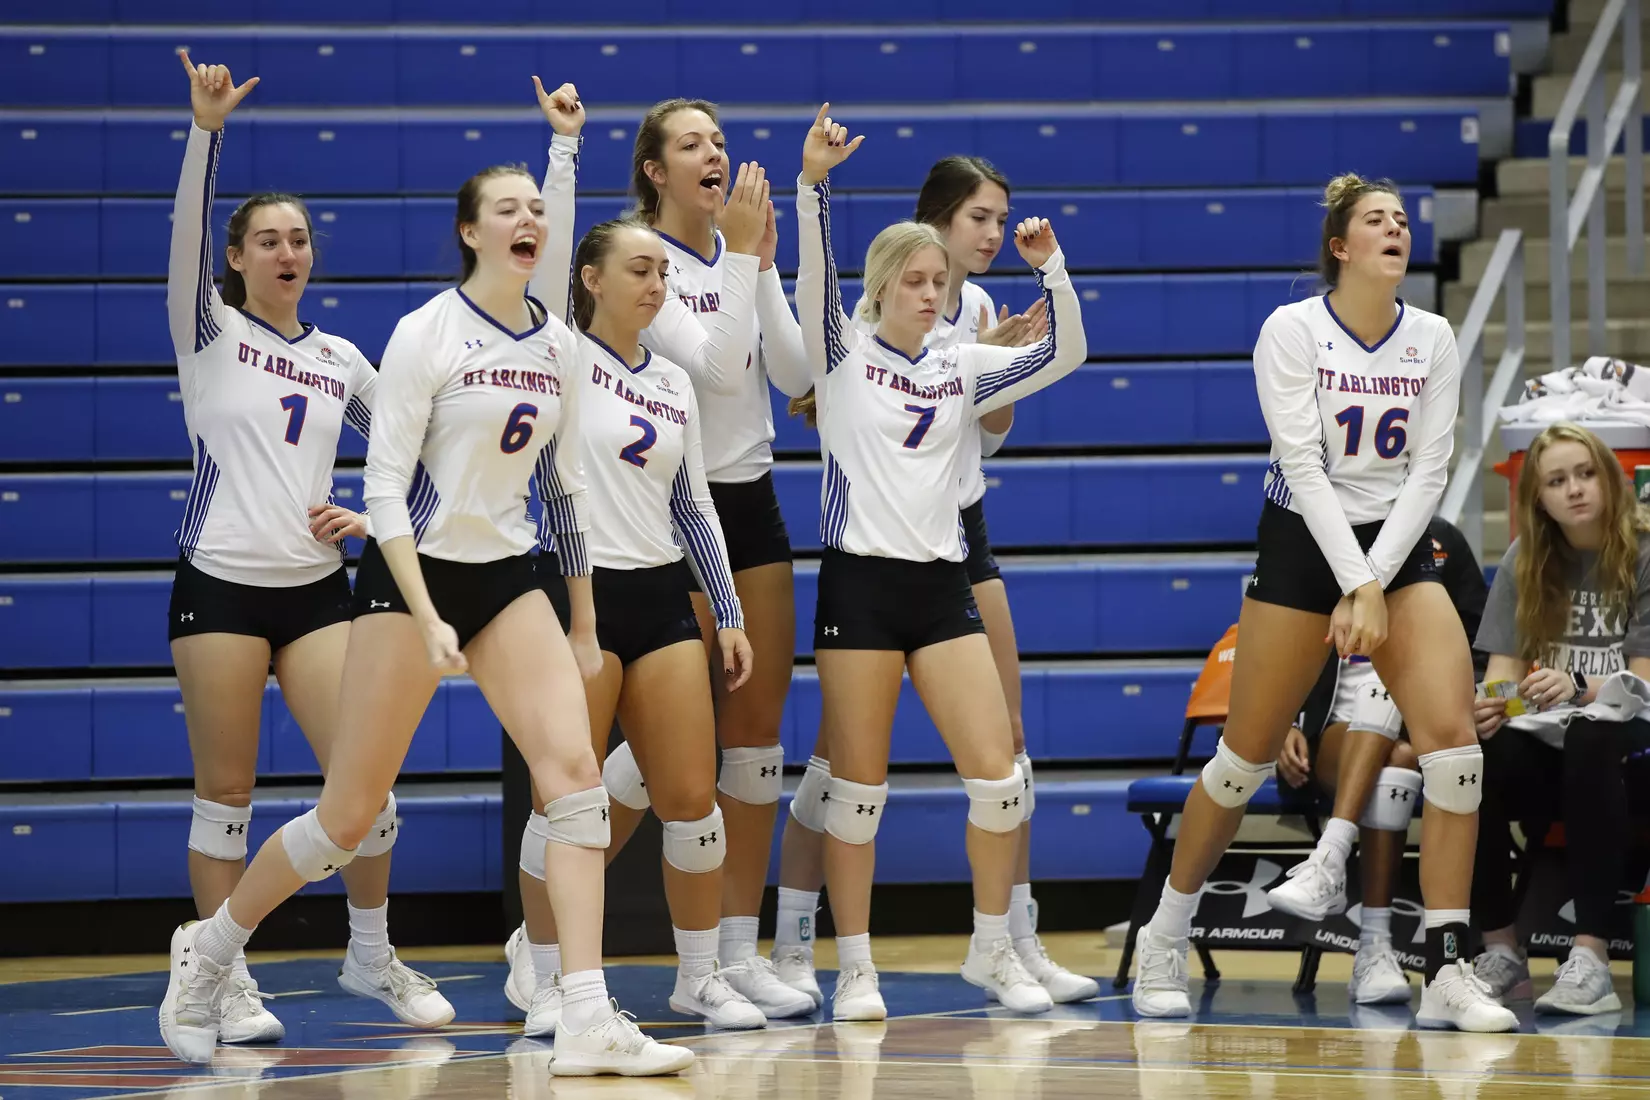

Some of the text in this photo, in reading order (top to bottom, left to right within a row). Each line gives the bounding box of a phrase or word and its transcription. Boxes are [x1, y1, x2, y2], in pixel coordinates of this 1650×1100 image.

[237, 341, 345, 402] UT ARLINGTON
[463, 369, 486, 386] UT
[591, 362, 613, 390] UT
[865, 363, 888, 387] UT
[1317, 366, 1336, 391] UT
[279, 393, 308, 446] 1
[499, 402, 538, 454] 6
[902, 403, 937, 449] 7
[1334, 405, 1410, 460] 16
[619, 414, 657, 469] 2
[1207, 927, 1286, 940] ARMOUR
[1314, 928, 1361, 951] UNDE
